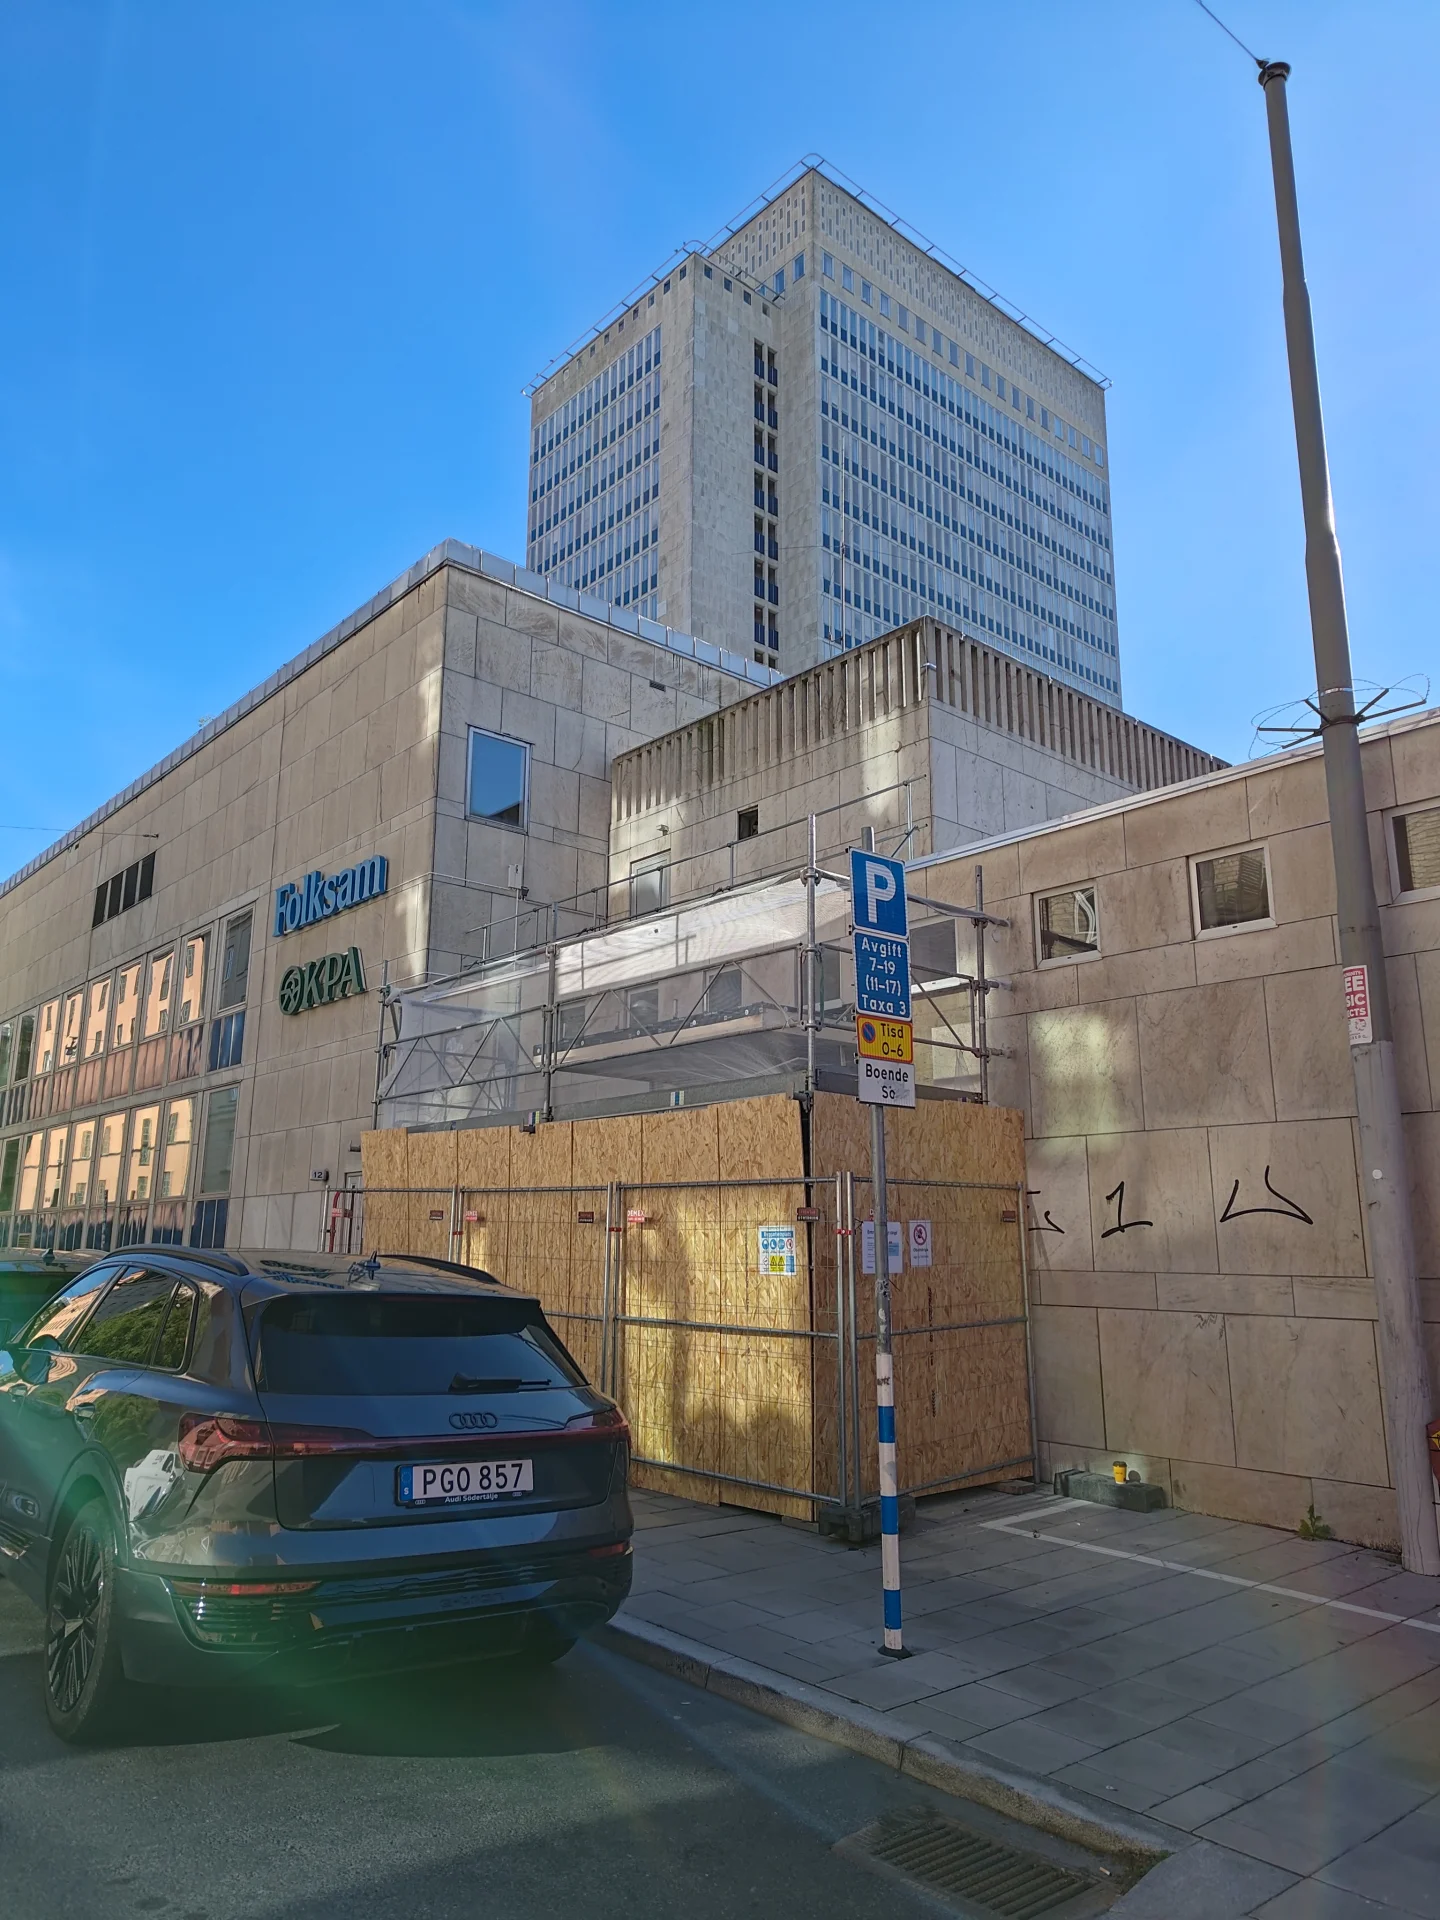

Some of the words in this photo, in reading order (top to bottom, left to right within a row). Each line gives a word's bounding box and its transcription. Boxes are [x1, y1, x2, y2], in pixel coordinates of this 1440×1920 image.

[272, 855, 388, 937] Folksam
[865, 860, 896, 923] P
[861, 937, 902, 958] Avgift
[869, 957, 895, 975] 7-19
[301, 946, 367, 1010] KPA
[865, 974, 901, 997] (11-17)
[1344, 974, 1365, 993] EE
[861, 993, 894, 1014] Taxa
[899, 1000, 907, 1015] 3
[1346, 993, 1366, 1008] SIC
[880, 1023, 904, 1039] Tisd
[865, 1063, 909, 1082] Boende
[313, 1171, 323, 1179] 12
[422, 1466, 471, 1496] PGO
[479, 1463, 523, 1491] 857
